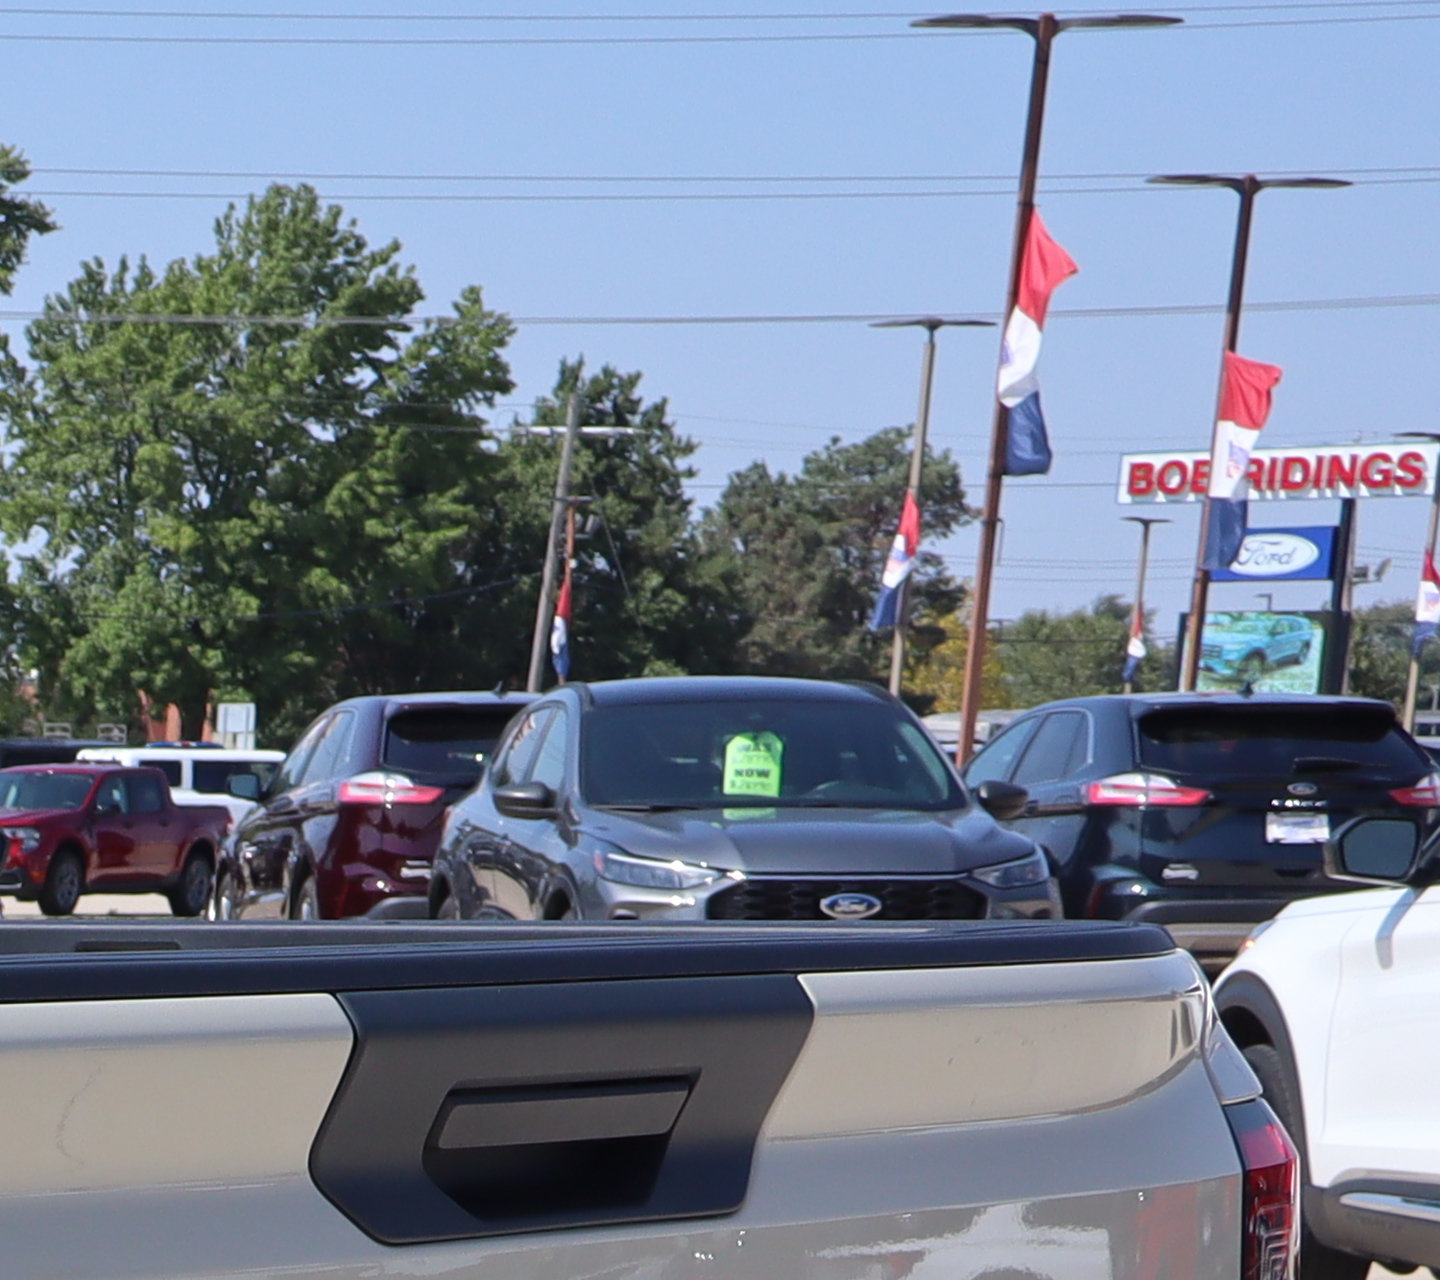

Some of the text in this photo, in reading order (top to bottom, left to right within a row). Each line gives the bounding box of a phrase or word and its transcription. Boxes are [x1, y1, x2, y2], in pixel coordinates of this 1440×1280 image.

[1247, 451, 1427, 491] RIDINGS
[1236, 540, 1297, 570] Ford
[734, 768, 771, 779] NOW
